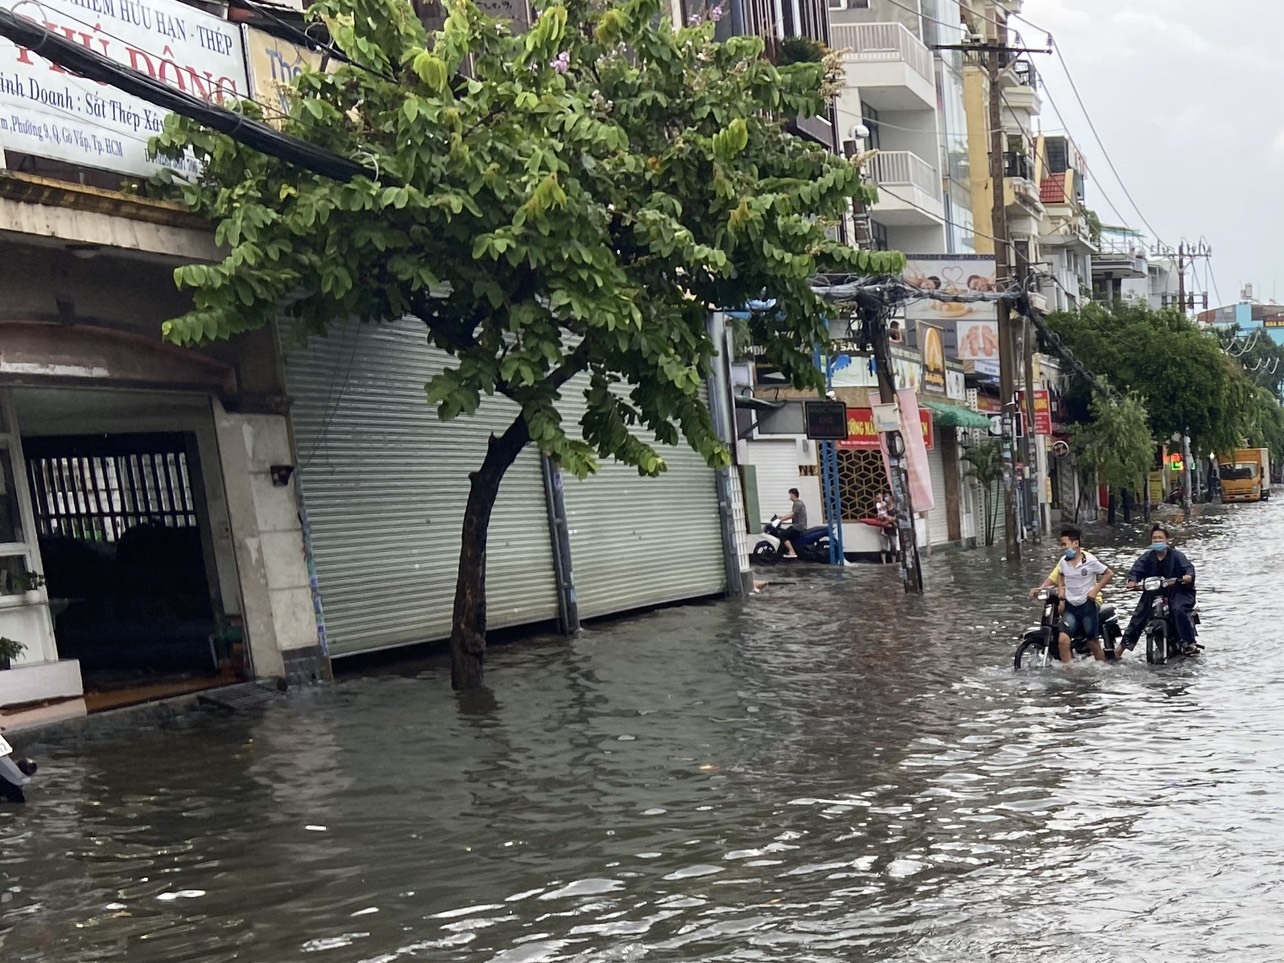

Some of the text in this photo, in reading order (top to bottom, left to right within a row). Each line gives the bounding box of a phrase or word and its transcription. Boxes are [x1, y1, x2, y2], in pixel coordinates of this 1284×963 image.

[154, 10, 187, 45] HẠN
[196, 24, 233, 57] THÉP
[0, 72, 24, 98] inh
[29, 77, 74, 111] Doanh
[110, 100, 140, 132] Thép
[105, 139, 123, 157] HCM
